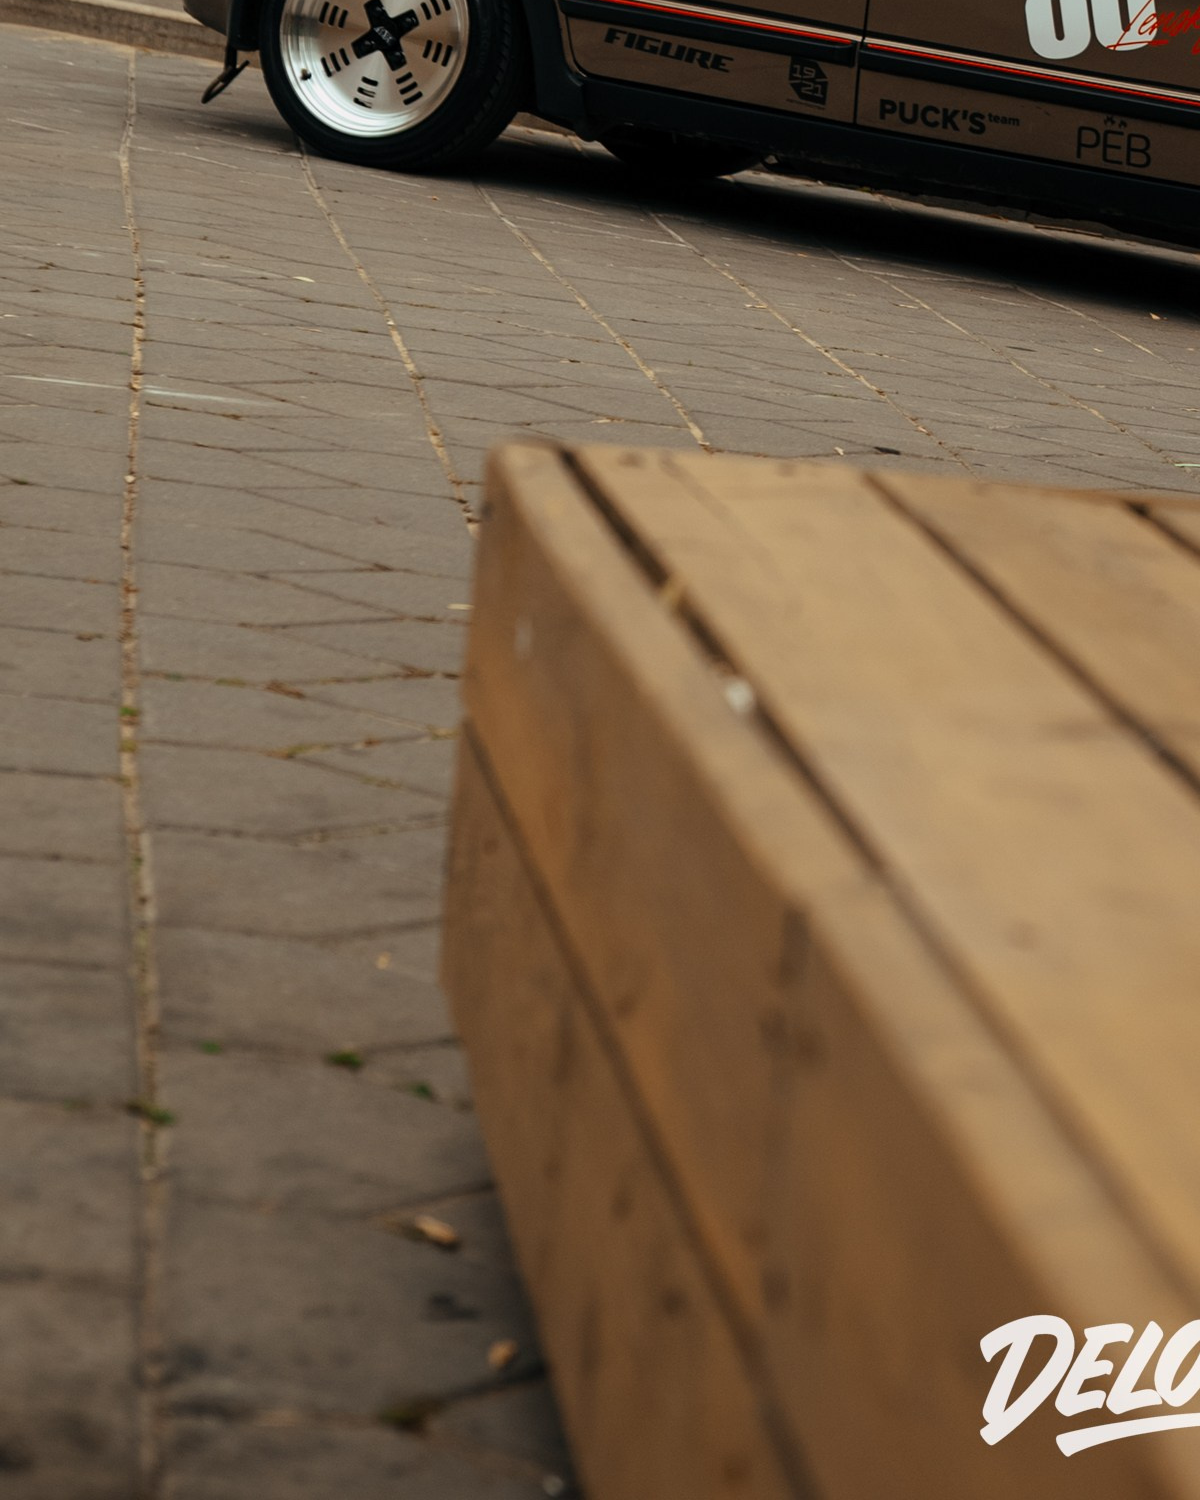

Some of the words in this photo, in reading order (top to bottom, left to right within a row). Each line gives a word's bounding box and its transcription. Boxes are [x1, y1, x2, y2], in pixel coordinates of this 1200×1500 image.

[604, 27, 735, 73] FIGURE
[791, 64, 816, 79] 19
[800, 80, 825, 99] 21
[879, 98, 986, 135] PUCK'S
[987, 112, 1021, 127] team
